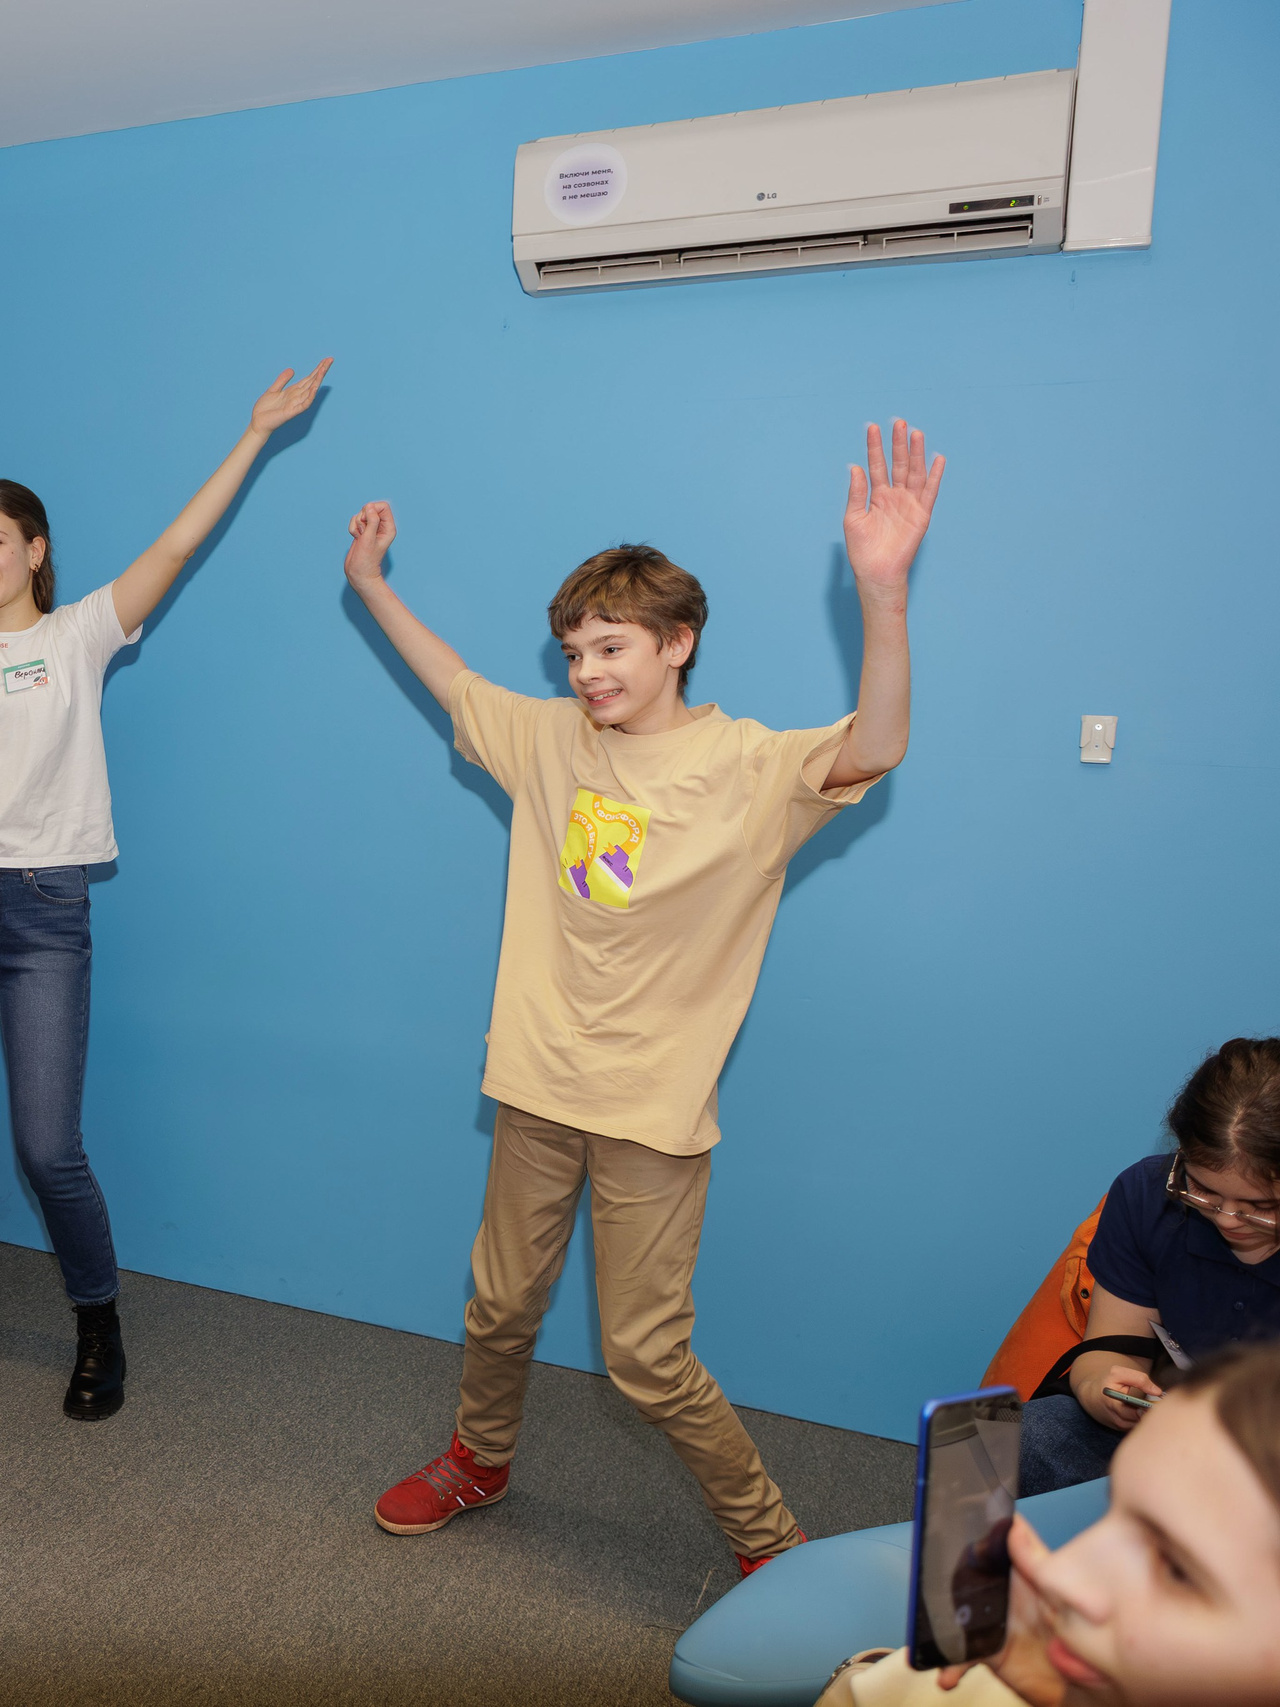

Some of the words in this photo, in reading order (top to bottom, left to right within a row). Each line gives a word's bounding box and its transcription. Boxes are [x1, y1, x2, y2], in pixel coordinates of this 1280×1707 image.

[559, 171, 589, 179] Включи
[573, 180, 609, 189] созвонах
[580, 190, 608, 199] мешаю
[766, 192, 777, 200] LG
[573, 812, 588, 825] ЭТО
[585, 823, 593, 832] Я
[597, 809, 640, 843] ФОКСФОРД
[588, 831, 596, 859] БЕГУ
